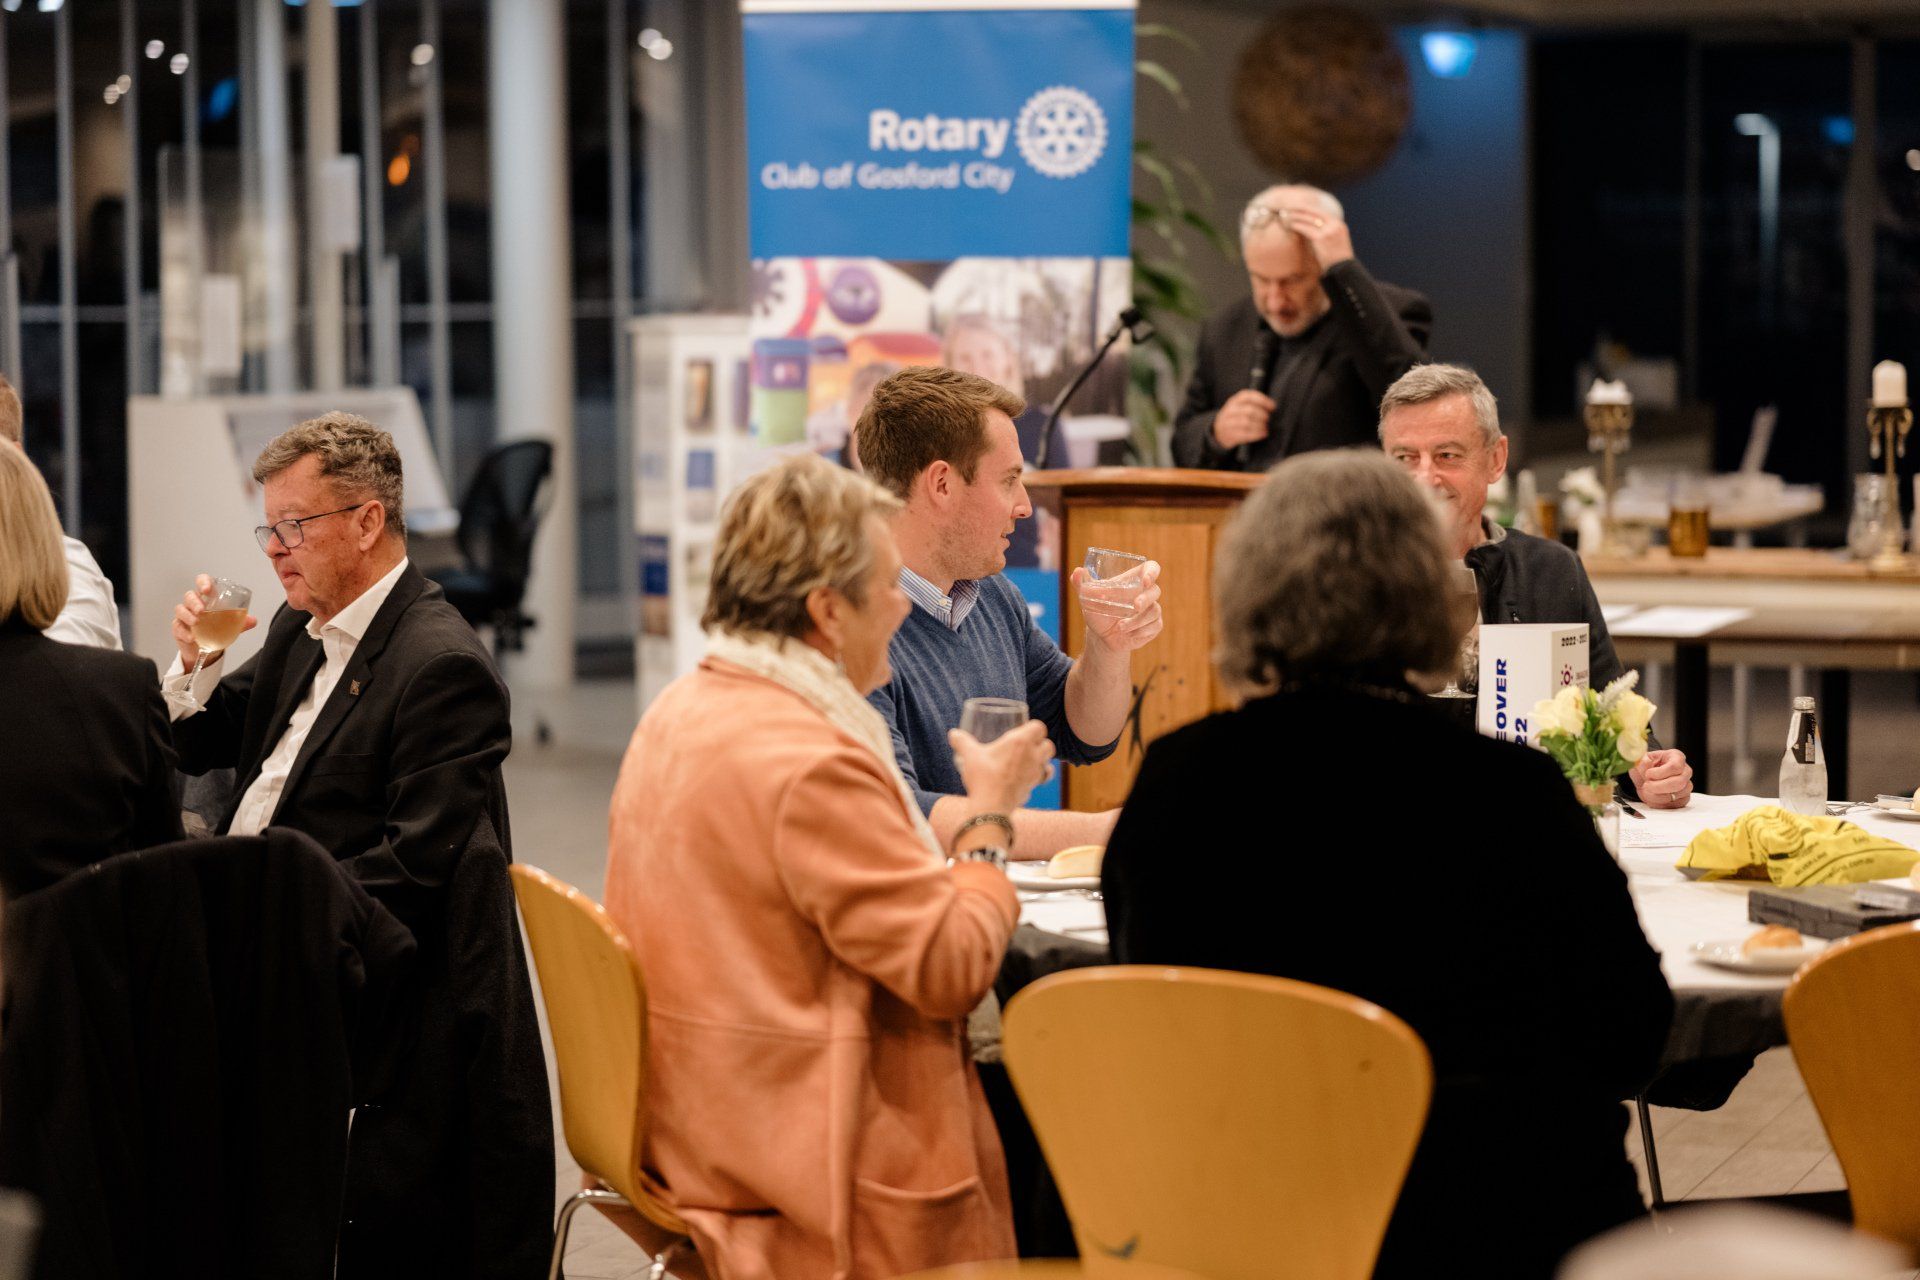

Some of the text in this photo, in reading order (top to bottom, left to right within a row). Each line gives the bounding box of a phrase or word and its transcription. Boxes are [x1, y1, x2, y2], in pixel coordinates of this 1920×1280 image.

[870, 110, 1008, 157] Rotary
[761, 162, 1015, 194] Club of Gosford City
